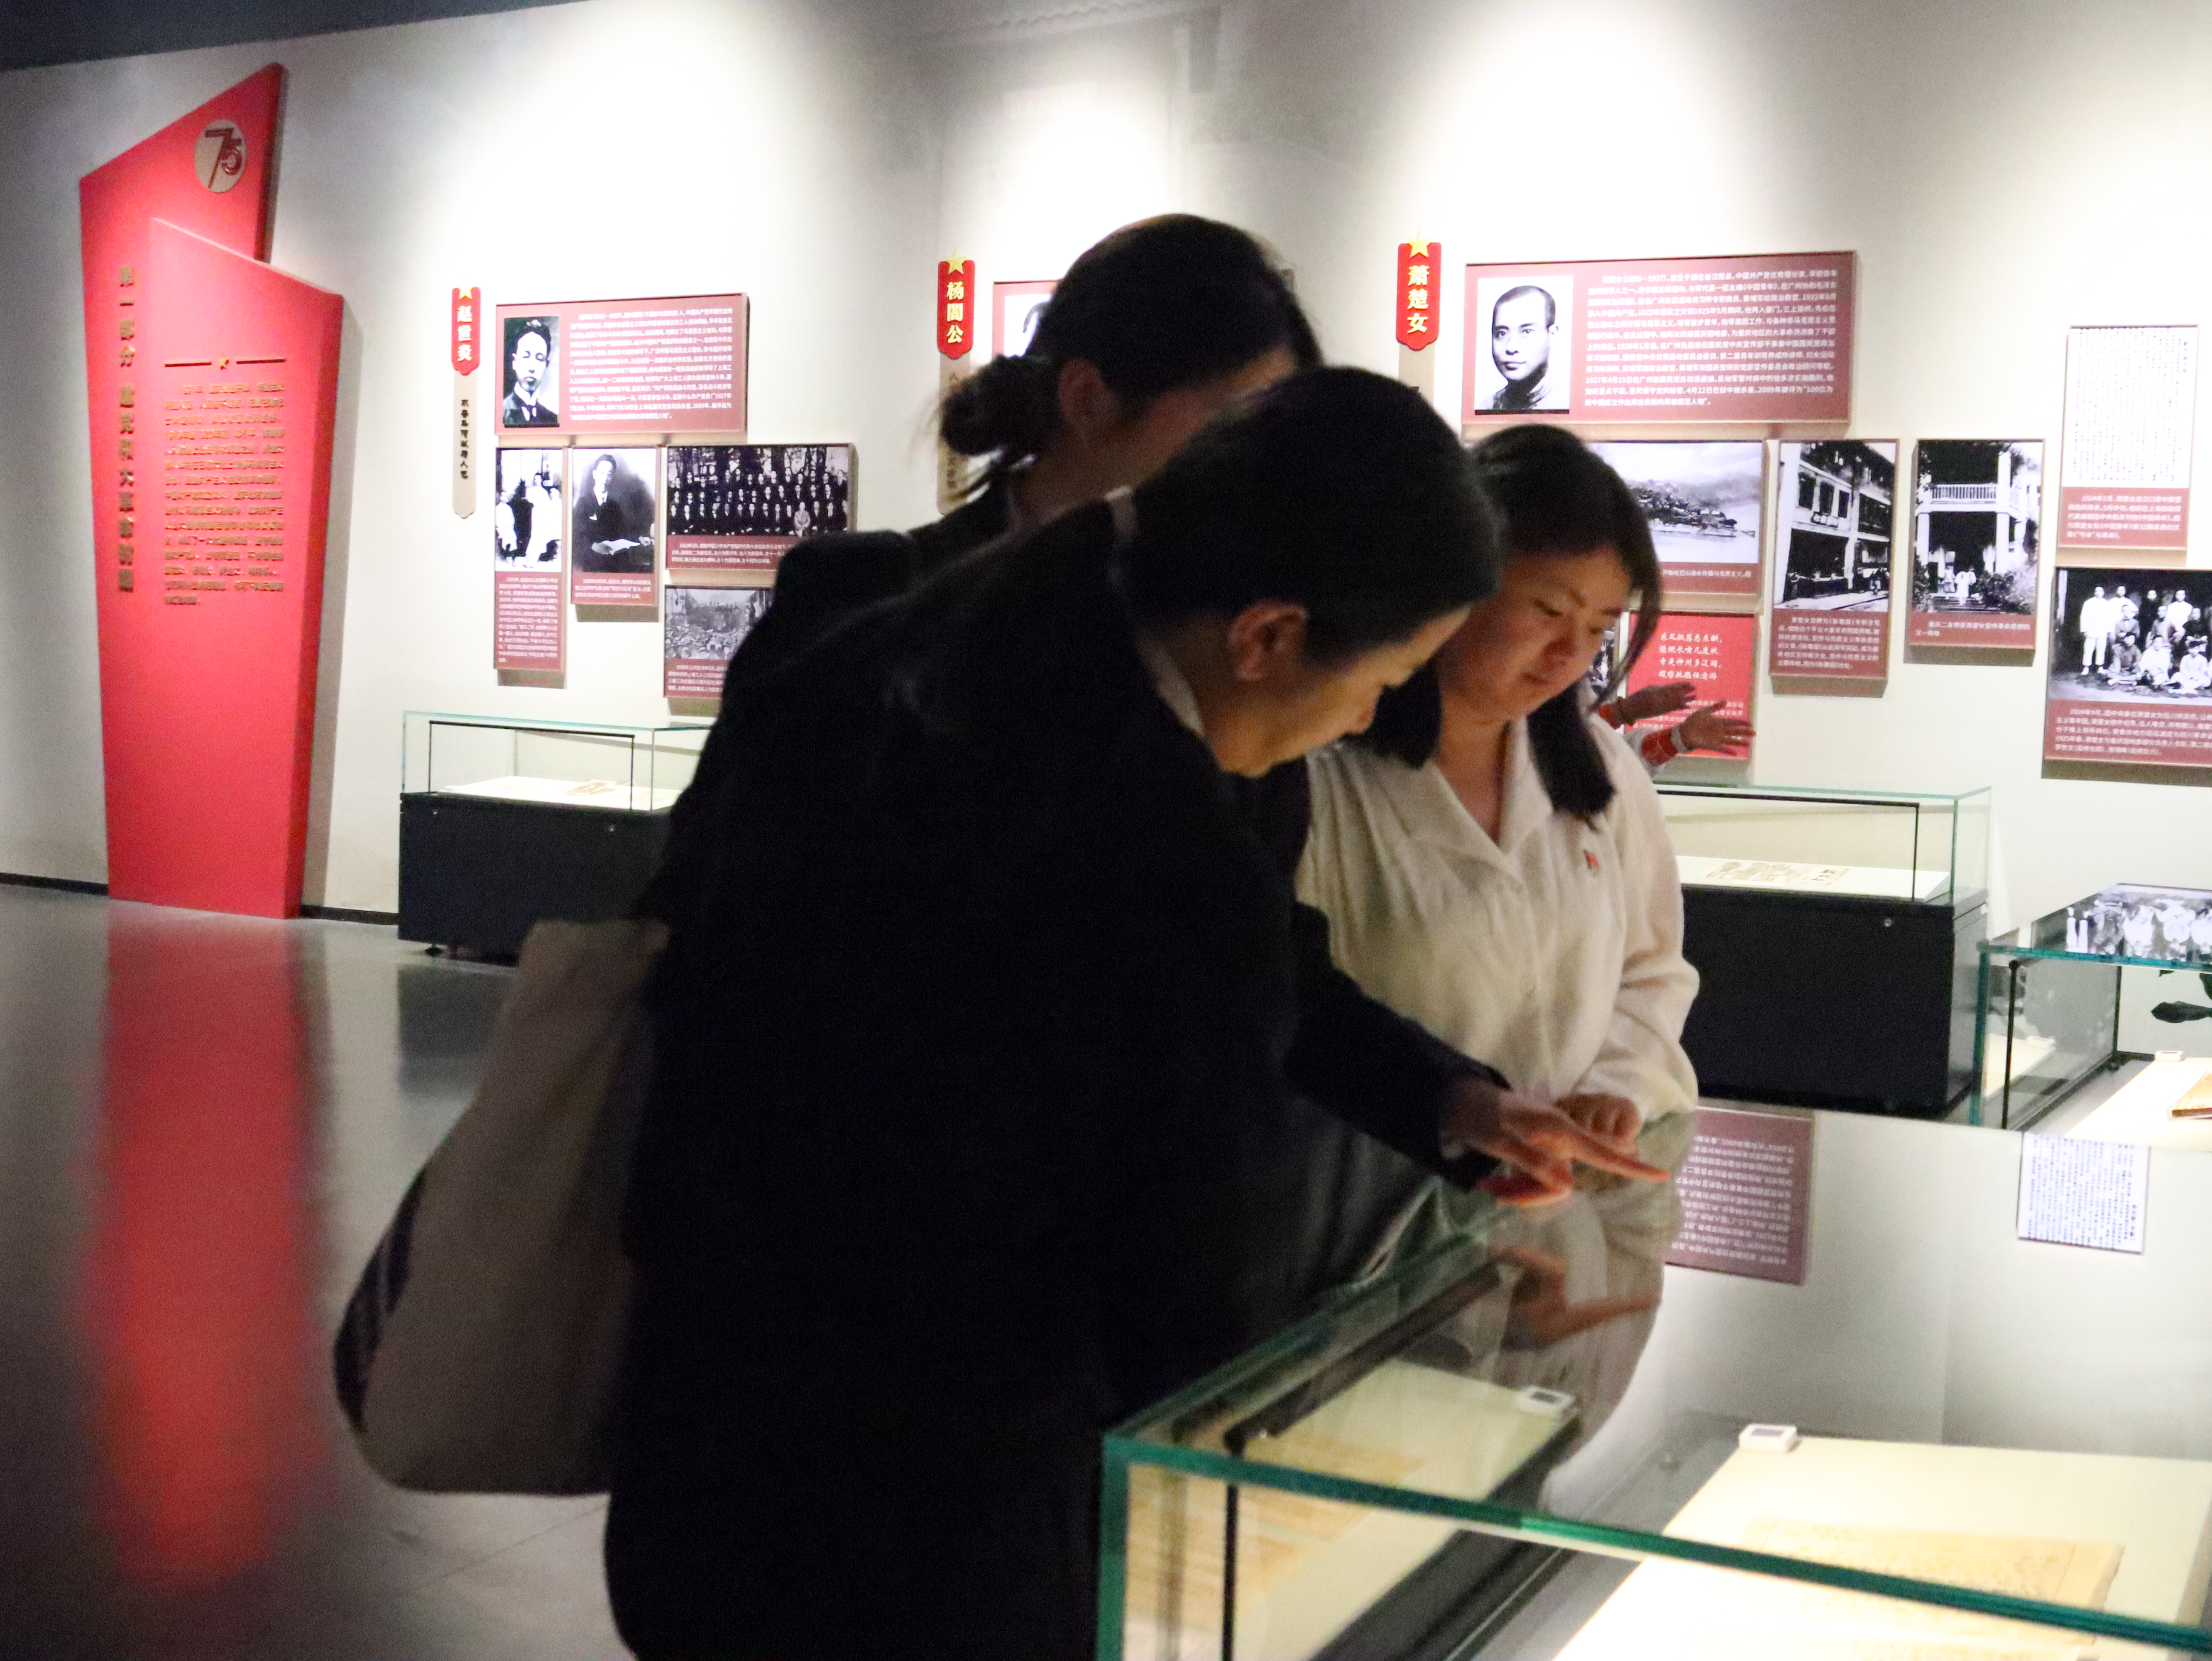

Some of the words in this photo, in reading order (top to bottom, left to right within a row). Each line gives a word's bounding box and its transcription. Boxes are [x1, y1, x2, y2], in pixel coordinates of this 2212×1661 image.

[946, 281, 964, 344] 杨闇公
[1407, 265, 1430, 334] 萧楚女
[457, 306, 472, 362] 赵世炎
